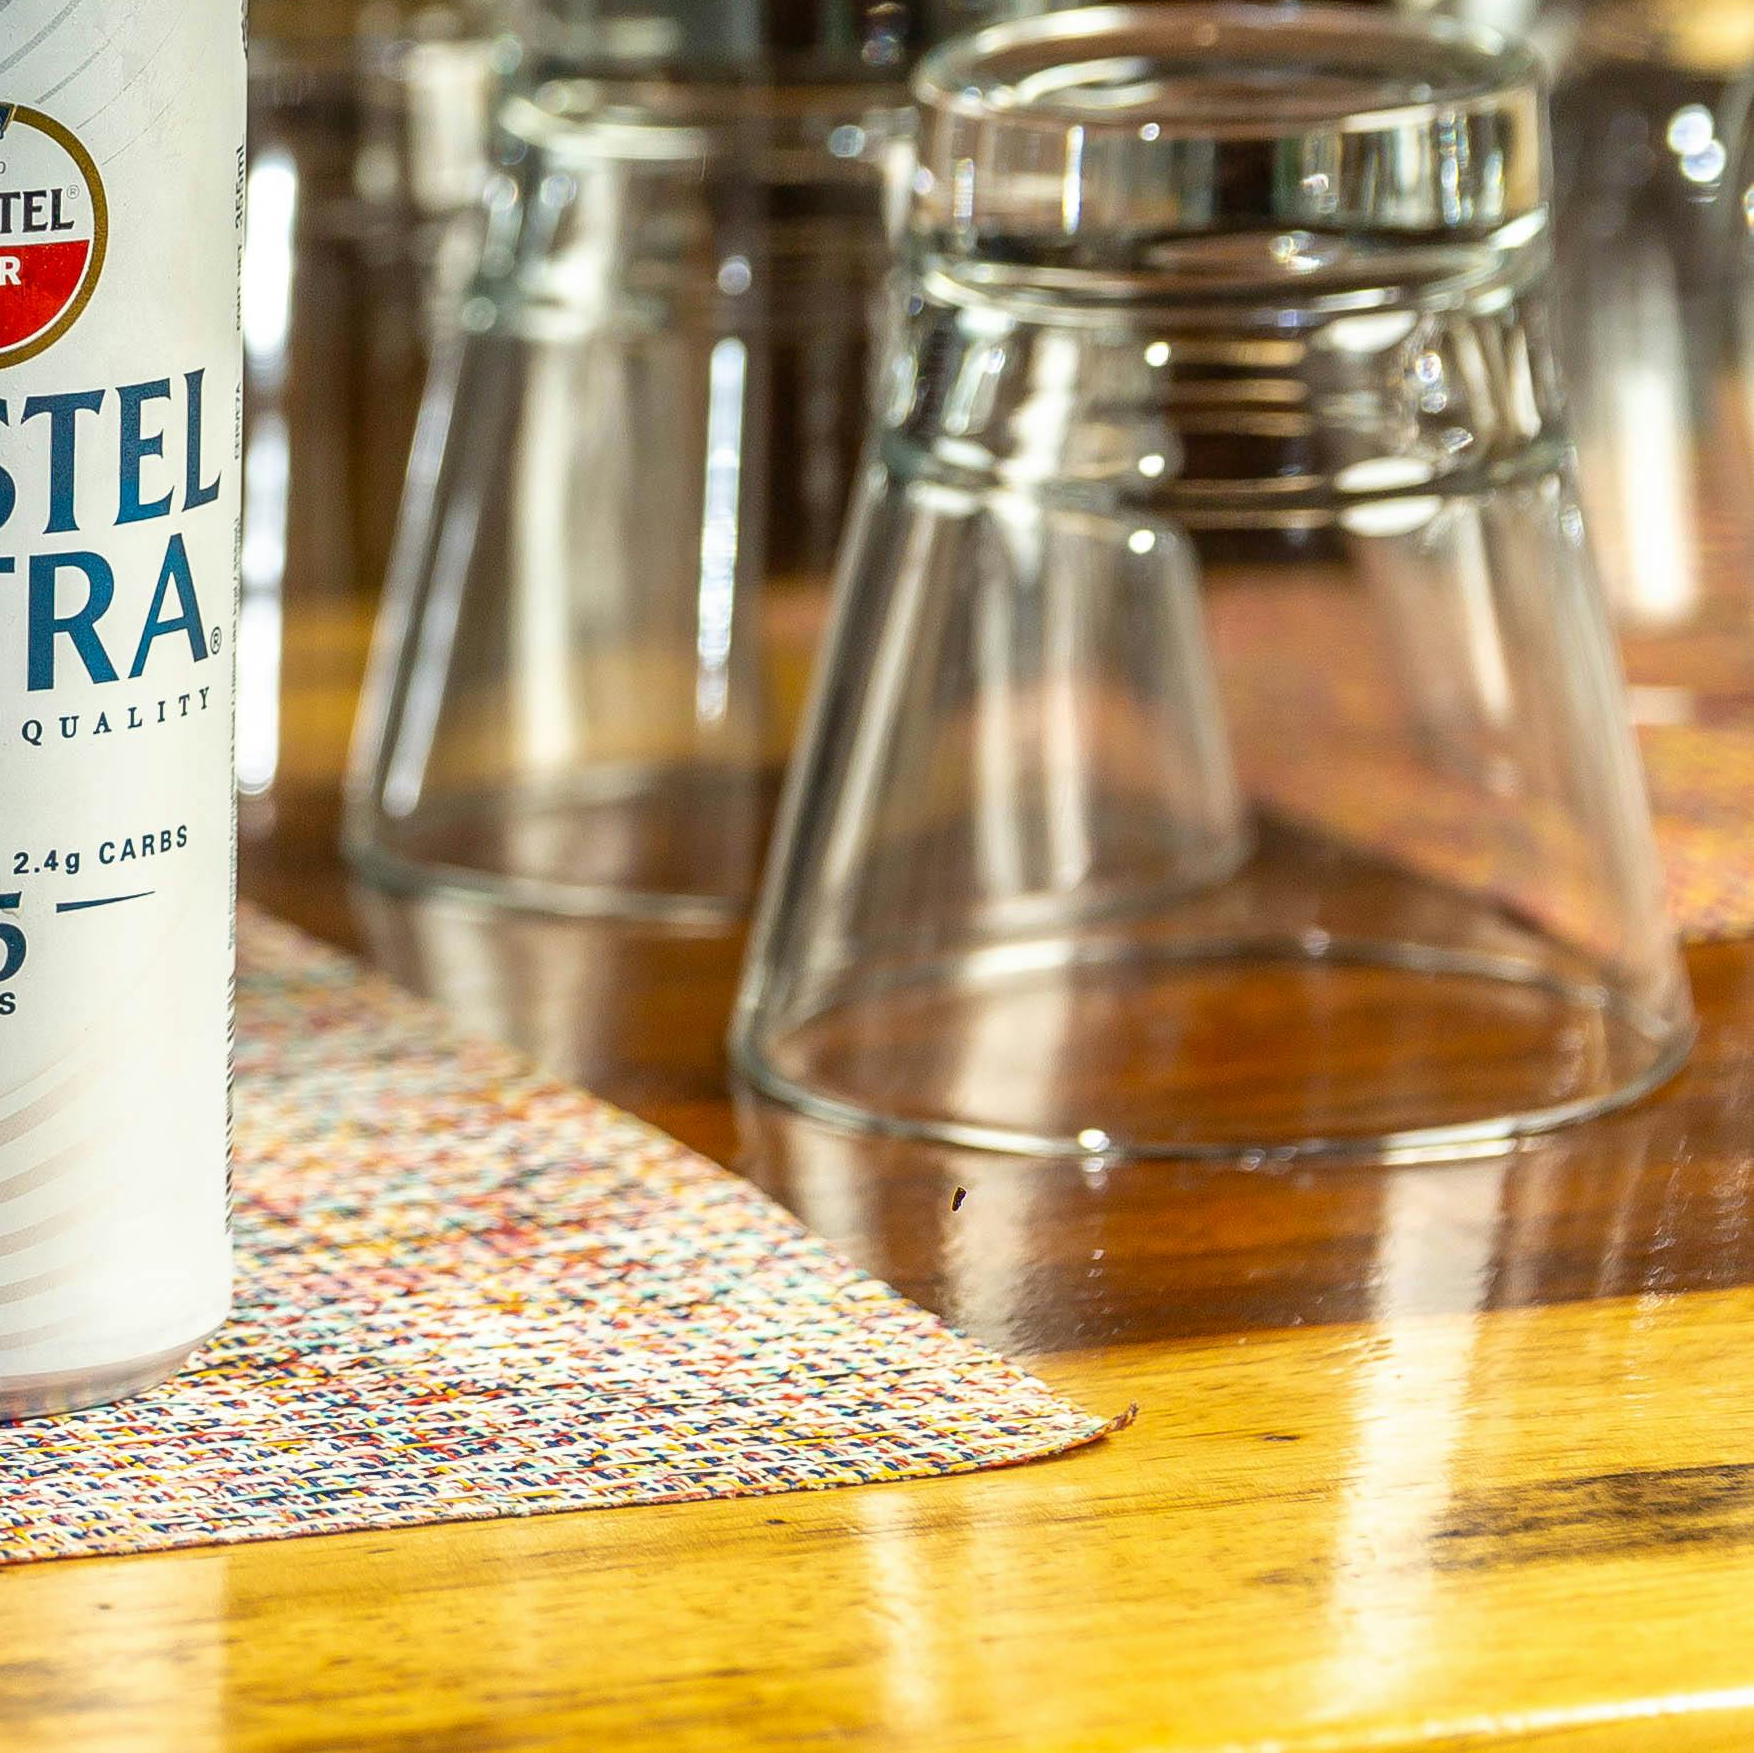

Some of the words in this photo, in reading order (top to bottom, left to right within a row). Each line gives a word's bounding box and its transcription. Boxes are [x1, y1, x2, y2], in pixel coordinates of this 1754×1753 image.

[20, 686, 212, 747] QUALITY
[12, 849, 81, 876] 2.4g
[97, 825, 190, 867] CARBS
